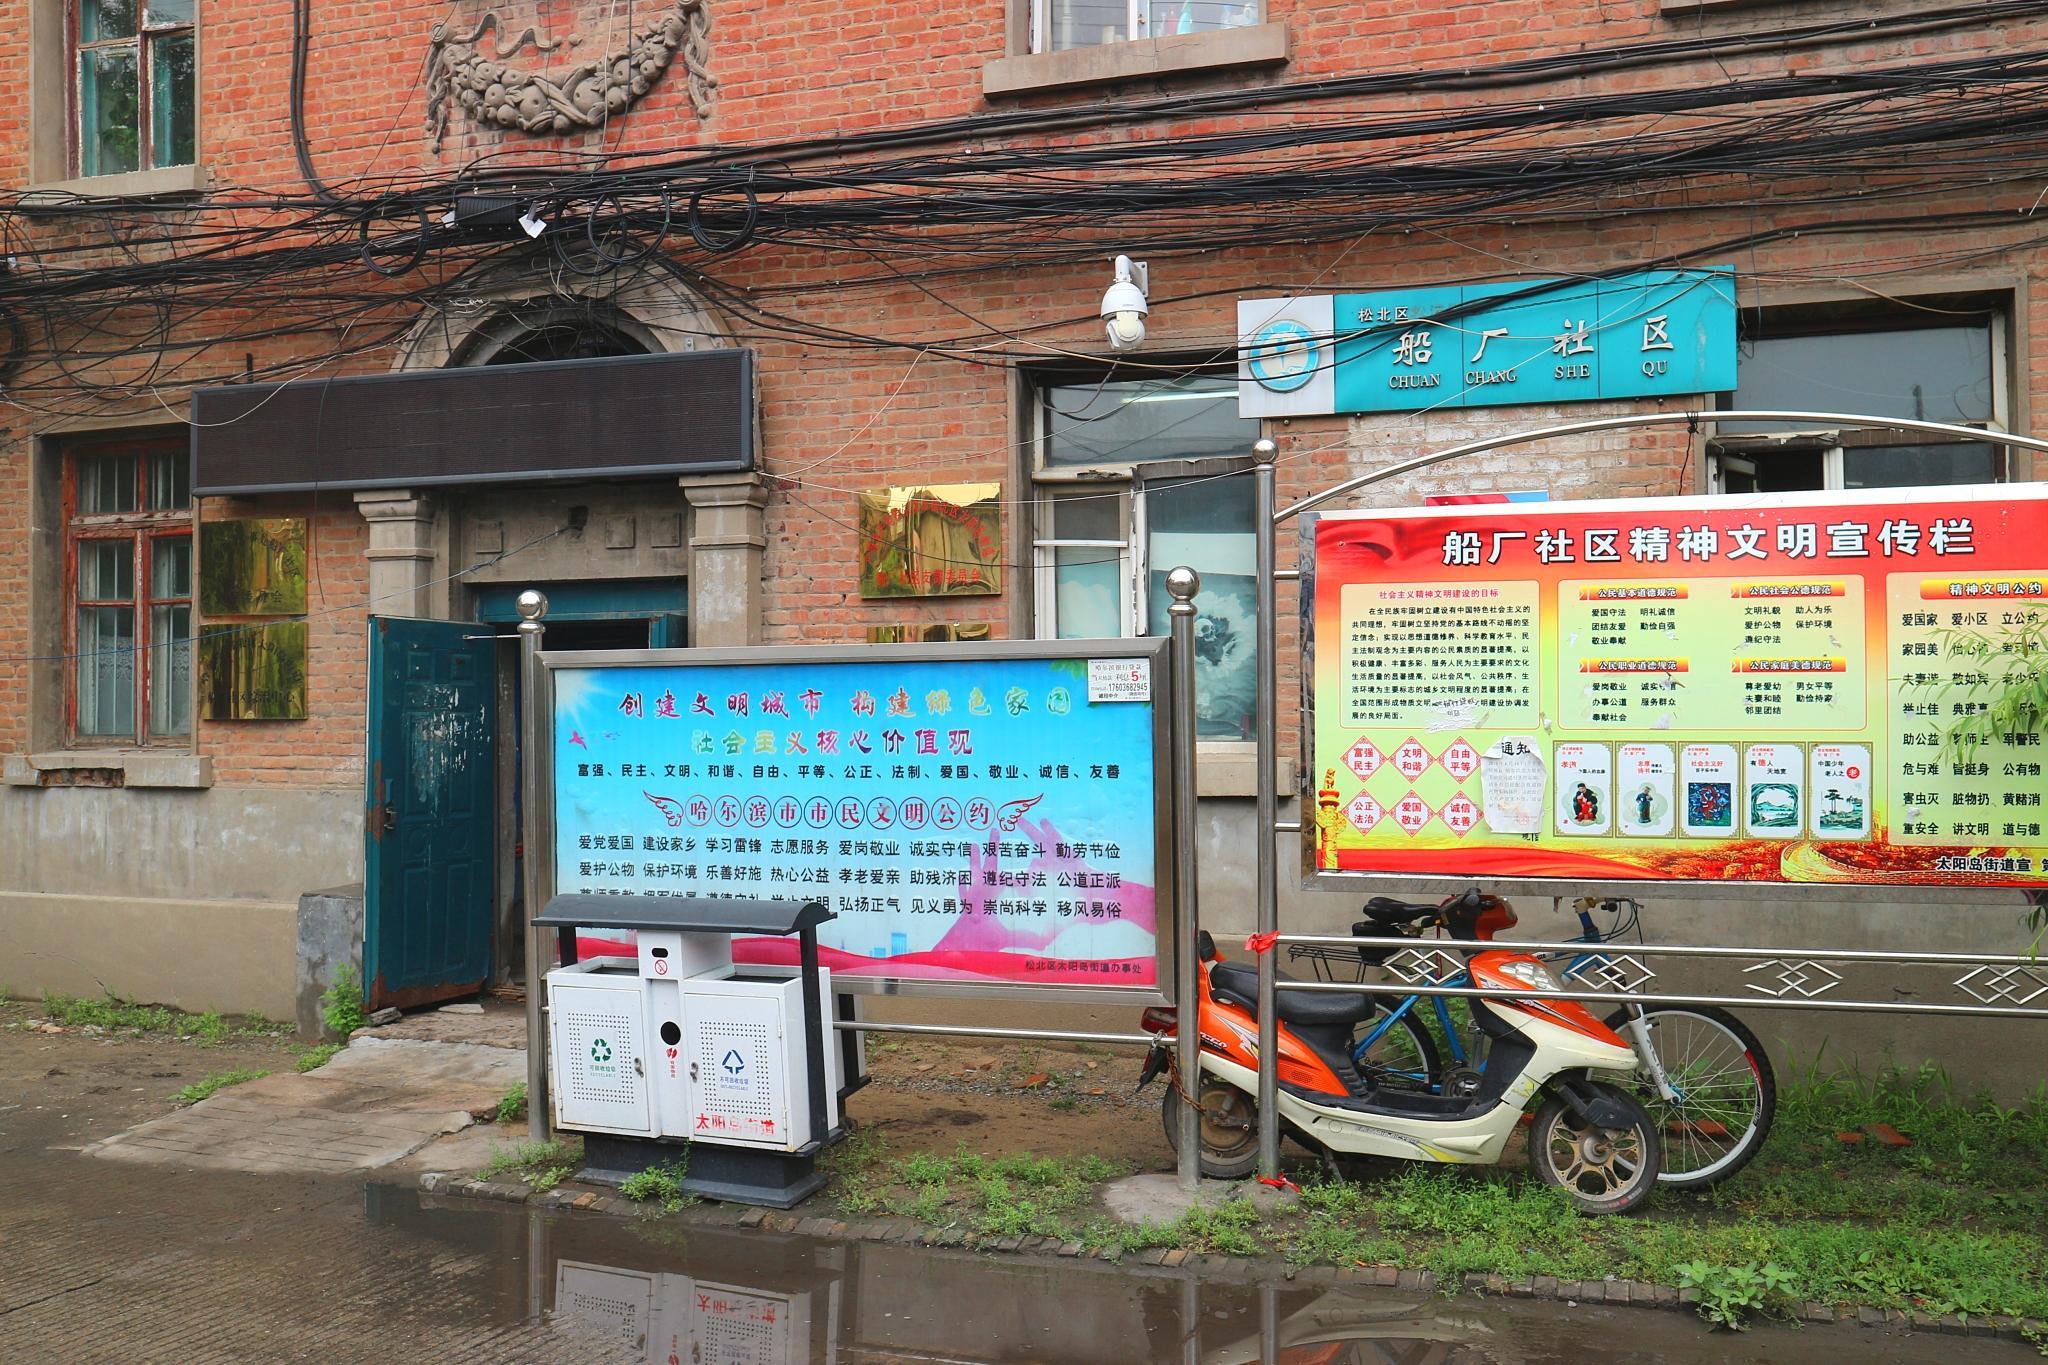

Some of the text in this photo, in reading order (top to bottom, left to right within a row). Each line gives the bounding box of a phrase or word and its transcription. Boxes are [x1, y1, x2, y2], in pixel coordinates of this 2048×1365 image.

[1359, 307, 1408, 321] 松北区
[1393, 315, 1674, 366] 船厂社区
[1389, 360, 1668, 389] CHUAN CHANG SHE QU
[1442, 519, 1976, 566] 船厂社区精神文明宣传栏
[1379, 589, 1499, 599] 社会主义精神文明建设的目标
[1599, 587, 1677, 598] 公民基本道德规范
[1750, 585, 1831, 595] 公民社会公德规范
[1950, 582, 2042, 596] 精神文明公约
[1592, 607, 1675, 617] 爱国守法 明礼诚信
[1745, 605, 1832, 615] 文明礼貌 助人为乐
[1902, 613, 1938, 626] 爱国家
[1952, 612, 1988, 625] 爱小区
[1592, 621, 1676, 631] 团结友爱 勤俭自强
[1745, 620, 1832, 629] 爱护公物 保护环境
[1592, 636, 1627, 645] 敬业奉献
[1745, 635, 1781, 644] 遵纪守法
[1902, 643, 1938, 656] 家园美
[1599, 661, 1677, 670] 公民职业道德规范
[1750, 660, 1832, 670] 公民家庭美德规范
[1592, 682, 1627, 691] 爱岗敬业
[1745, 681, 1833, 691] 尊老爱幼 男女平等
[619, 687, 1071, 719] 创建文明城市 构建绿色家园
[1592, 698, 1676, 706] 办事公道 服务群众
[1745, 694, 1833, 703] 夫妻和睦 勤俭持家
[1745, 706, 1781, 715] 邻里团结
[1903, 703, 1939, 716] 举止佳
[1592, 713, 1627, 722] 奉献社会
[692, 729, 974, 755] 社会主义核心价值观
[1903, 733, 1940, 746] 助公益
[1353, 748, 1373, 758] 富强
[1402, 748, 1422, 758] 文明
[1501, 741, 1530, 756] 通知
[1451, 749, 1471, 759] 自由
[1353, 761, 1374, 771] 民主
[1402, 761, 1422, 772] 和谐
[1450, 762, 1471, 772] 平等
[1818, 760, 1845, 768] 中国少年
[1903, 763, 2041, 776] 危与难 皆挺身 公有物
[1903, 792, 2041, 806] 害虫灭 脏物扔 黄赌消
[1353, 801, 1374, 811] 公正
[1401, 802, 1422, 812] 爱国
[1450, 803, 1470, 813] 诚信
[690, 800, 989, 825] 哈尔滨市市民文明公约
[1353, 815, 1374, 825] 法治
[1401, 815, 1421, 825] 敬业
[1450, 816, 1471, 826] 友善
[1903, 822, 2041, 836] 重安全 讲文明 道与德
[579, 835, 1120, 859] 爱党爱国 建设家乡 学习雷锋 志愿服务 爱岗敬业 诚实守信 艰苦奋斗 勤劳节俭
[1937, 857, 2031, 873] 太阳岛街道宣
[579, 862, 1121, 888] 爱护公物 保护环境 乐善好施 热心公益 孝老爱亲 助残济困 遵纪守法 公道正派
[839, 897, 901, 913] 弘扬正气
[911, 898, 973, 915] 见义勇为
[983, 899, 1047, 917] 崇尚科学
[1057, 900, 1122, 918] 移风易俗
[1026, 960, 1142, 974] 松北区太阳岛街道办事处
